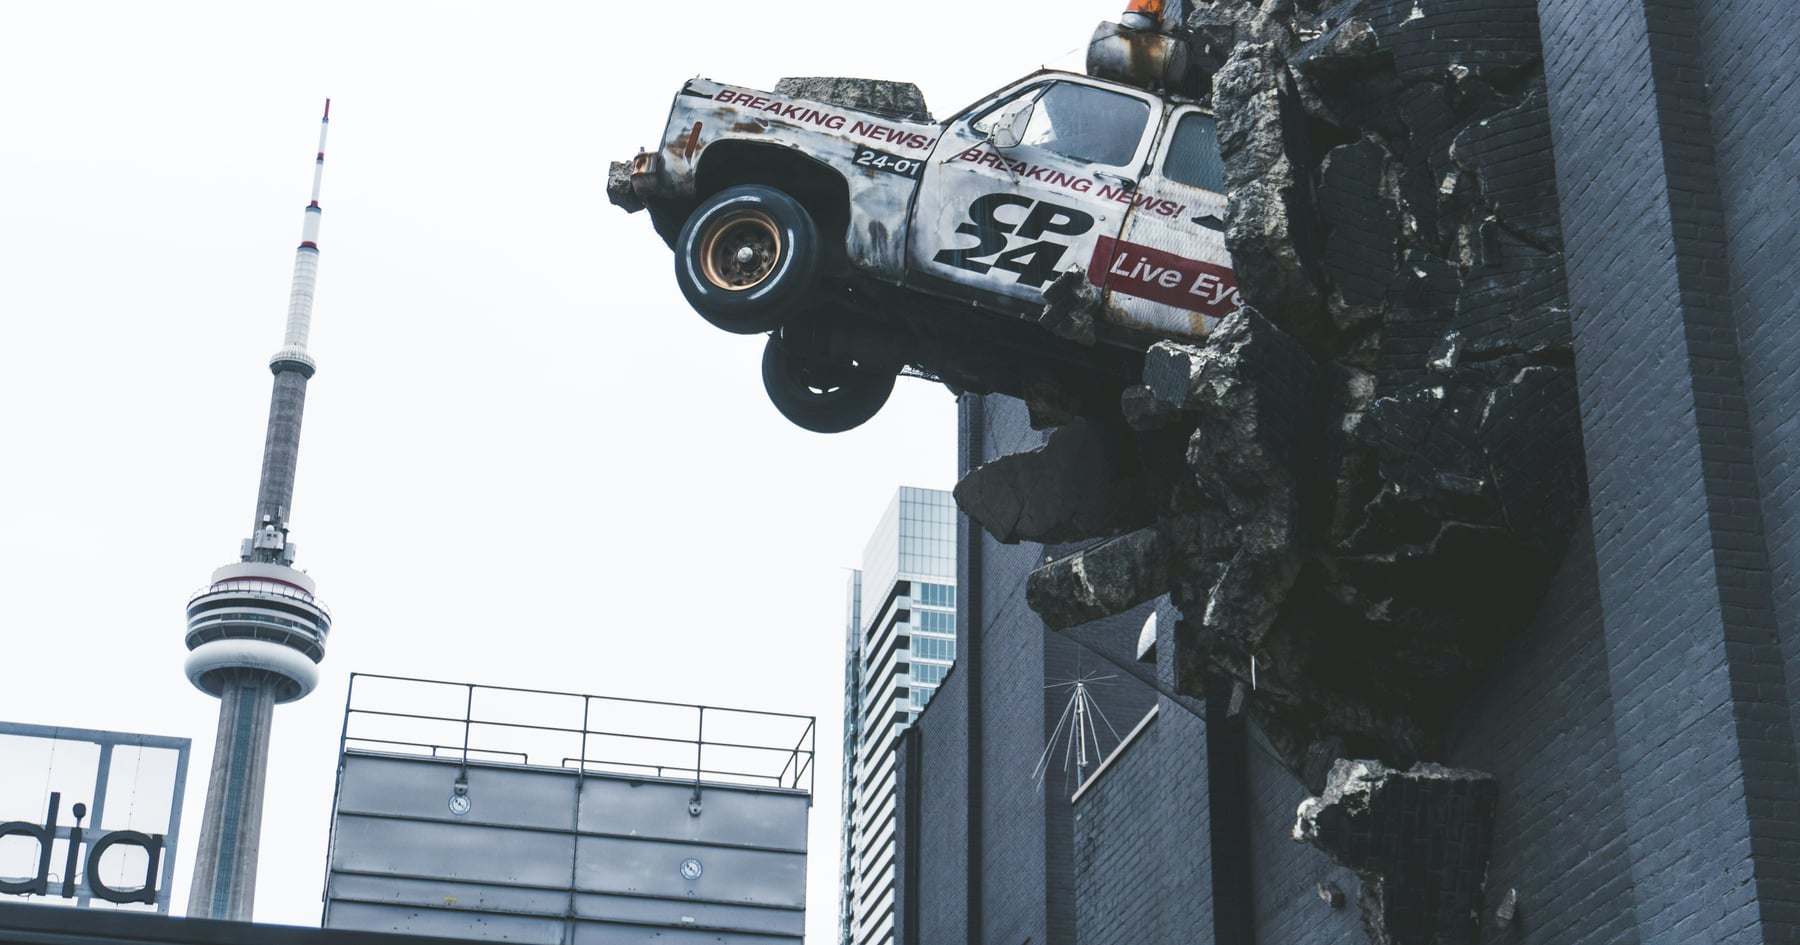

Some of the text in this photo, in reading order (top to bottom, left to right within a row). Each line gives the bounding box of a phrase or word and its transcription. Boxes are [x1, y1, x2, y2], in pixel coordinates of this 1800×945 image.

[715, 89, 935, 150] BREAKING NEWS!
[856, 151, 921, 176] 24-01
[959, 148, 1186, 218] BREAKING NEWS!
[969, 192, 1095, 240] CP
[932, 222, 1068, 288] 24
[1109, 252, 1183, 288] Live
[0, 791, 163, 905] dia
